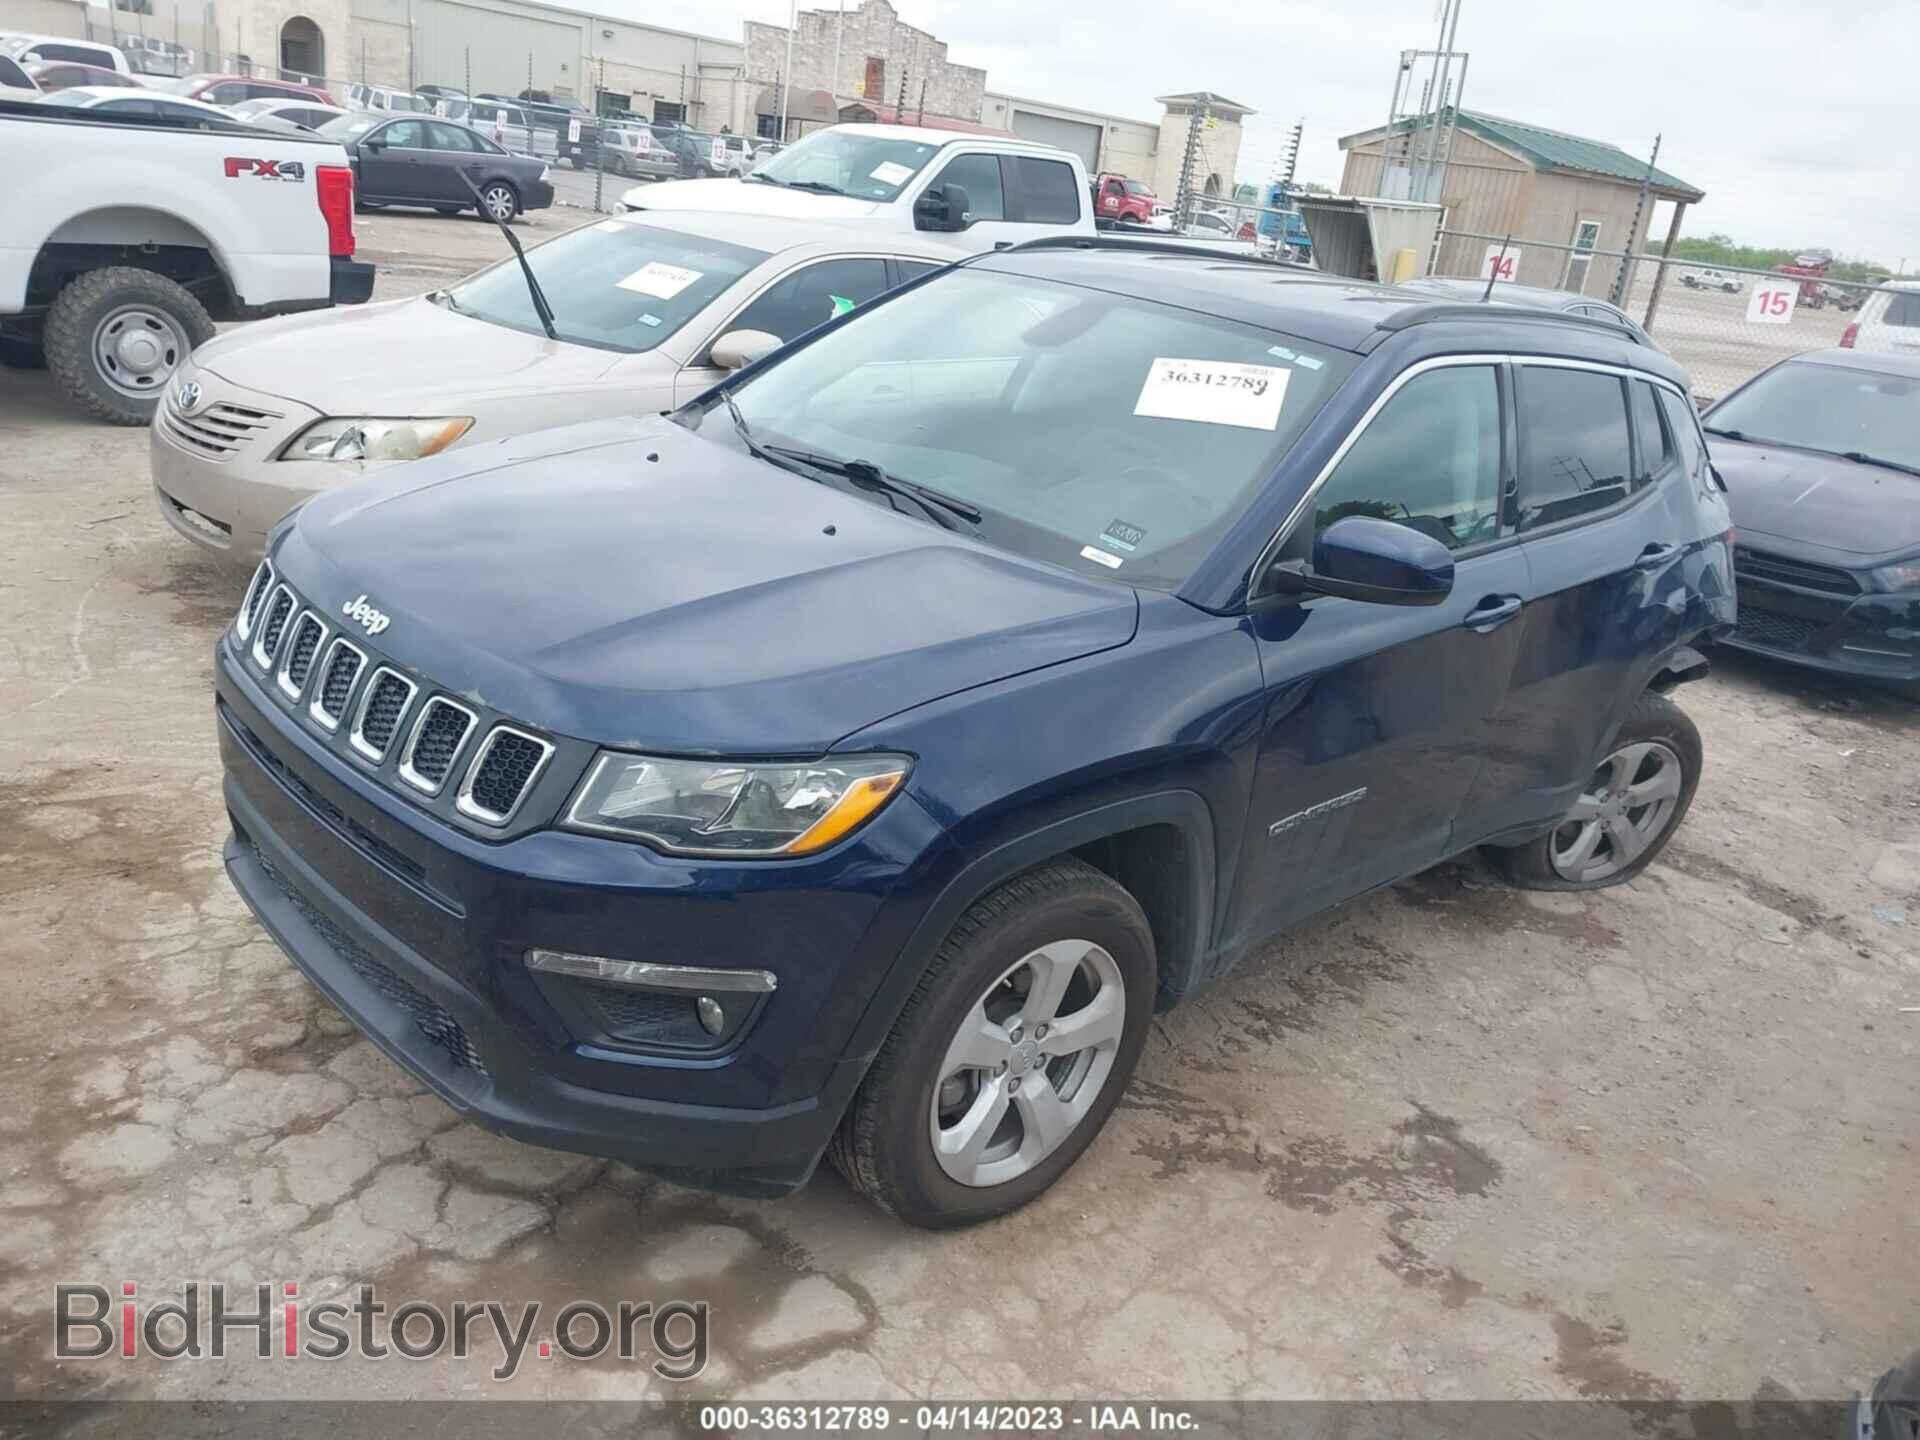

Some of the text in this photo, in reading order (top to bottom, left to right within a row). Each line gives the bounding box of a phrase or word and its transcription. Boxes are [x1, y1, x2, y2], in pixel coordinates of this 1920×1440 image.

[639, 135, 650, 149] 12
[224, 157, 304, 179] FX4
[1490, 255, 1513, 279] 14
[1759, 291, 1790, 315] 15
[1161, 370, 1269, 396] 36312789
[342, 595, 390, 635] Jeep
